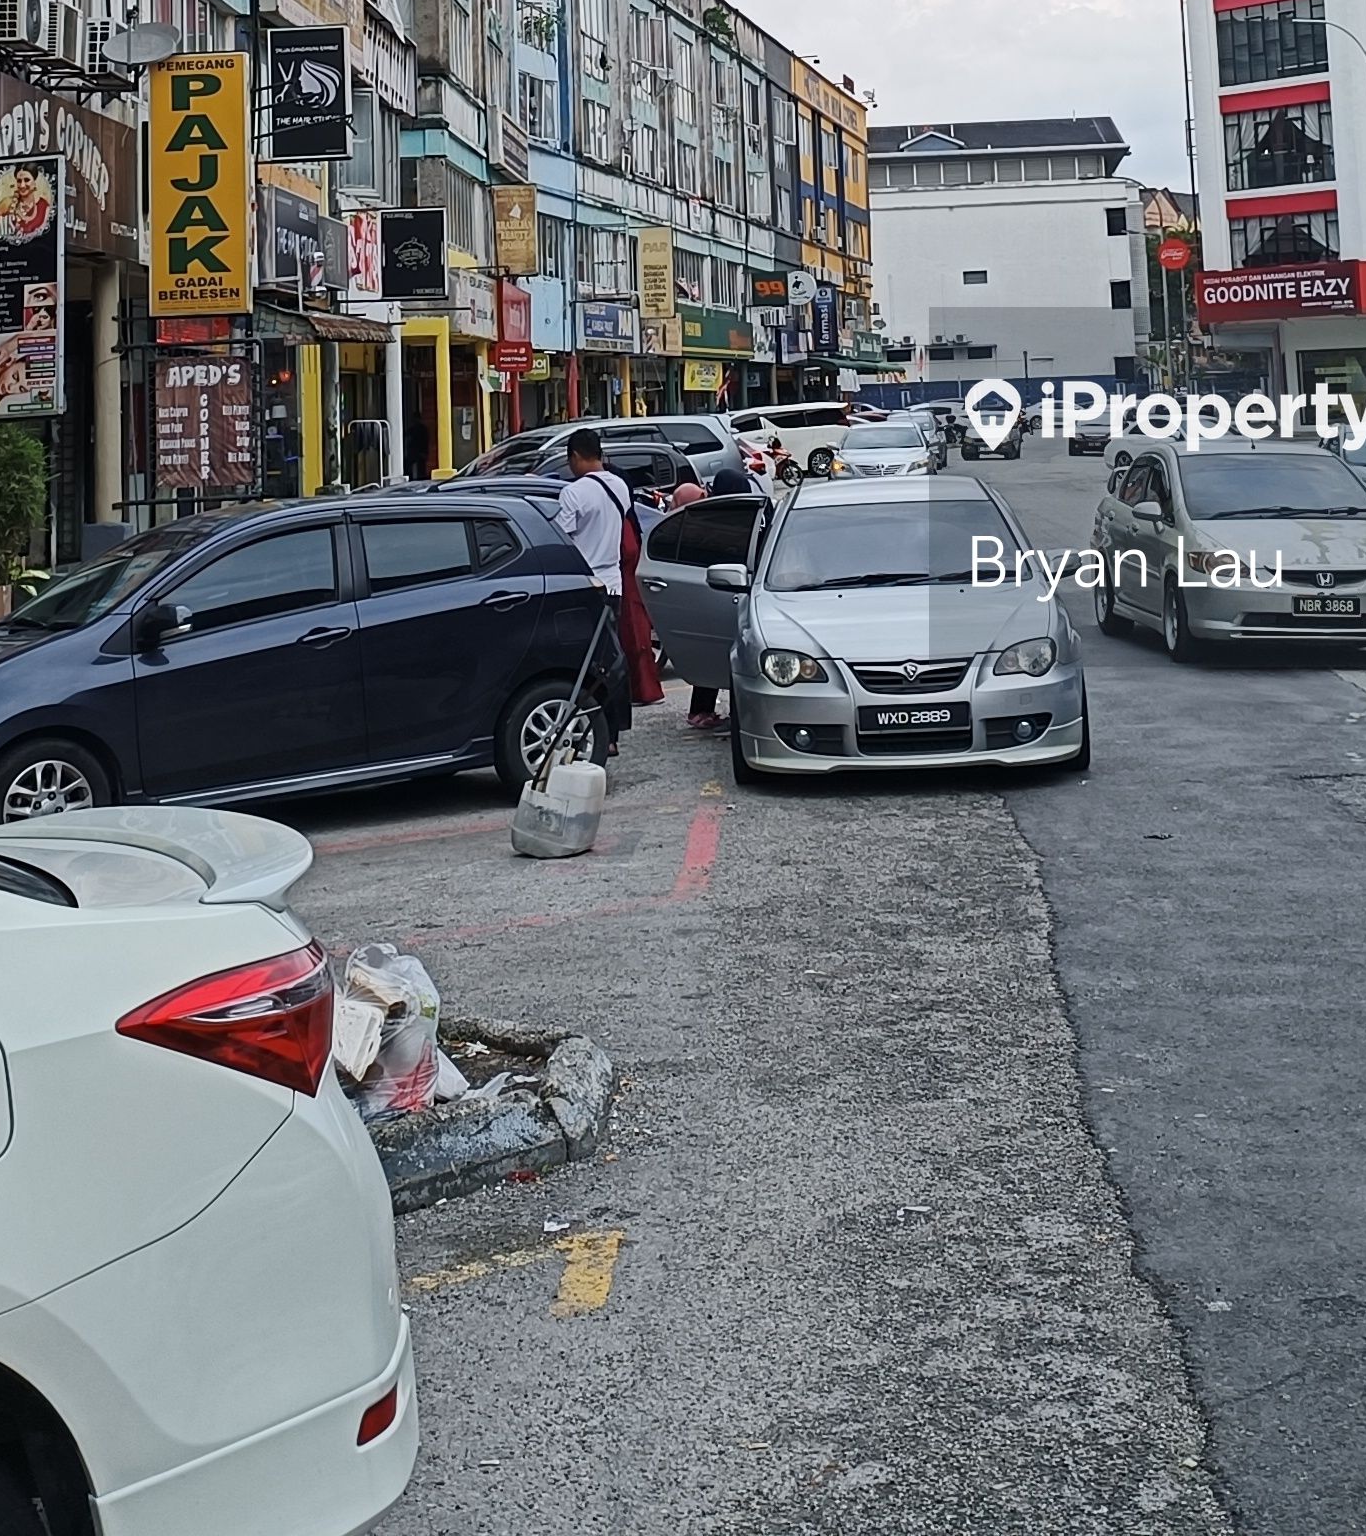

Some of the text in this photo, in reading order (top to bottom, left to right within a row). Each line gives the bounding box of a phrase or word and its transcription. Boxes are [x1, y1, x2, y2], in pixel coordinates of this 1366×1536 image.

[157, 58, 235, 72] PEMEGANG
[56, 106, 111, 212] CORNER
[164, 73, 232, 275] PAJAK
[174, 276, 223, 289] GADAI
[755, 280, 785, 298] 99
[1203, 277, 1351, 305] GOODNITE EAZY
[158, 287, 240, 301] BERLESEN
[819, 304, 830, 345] farmasi
[165, 364, 241, 388] APED'S
[1299, 598, 1322, 613] NBR
[877, 710, 951, 725] WXD 2889
